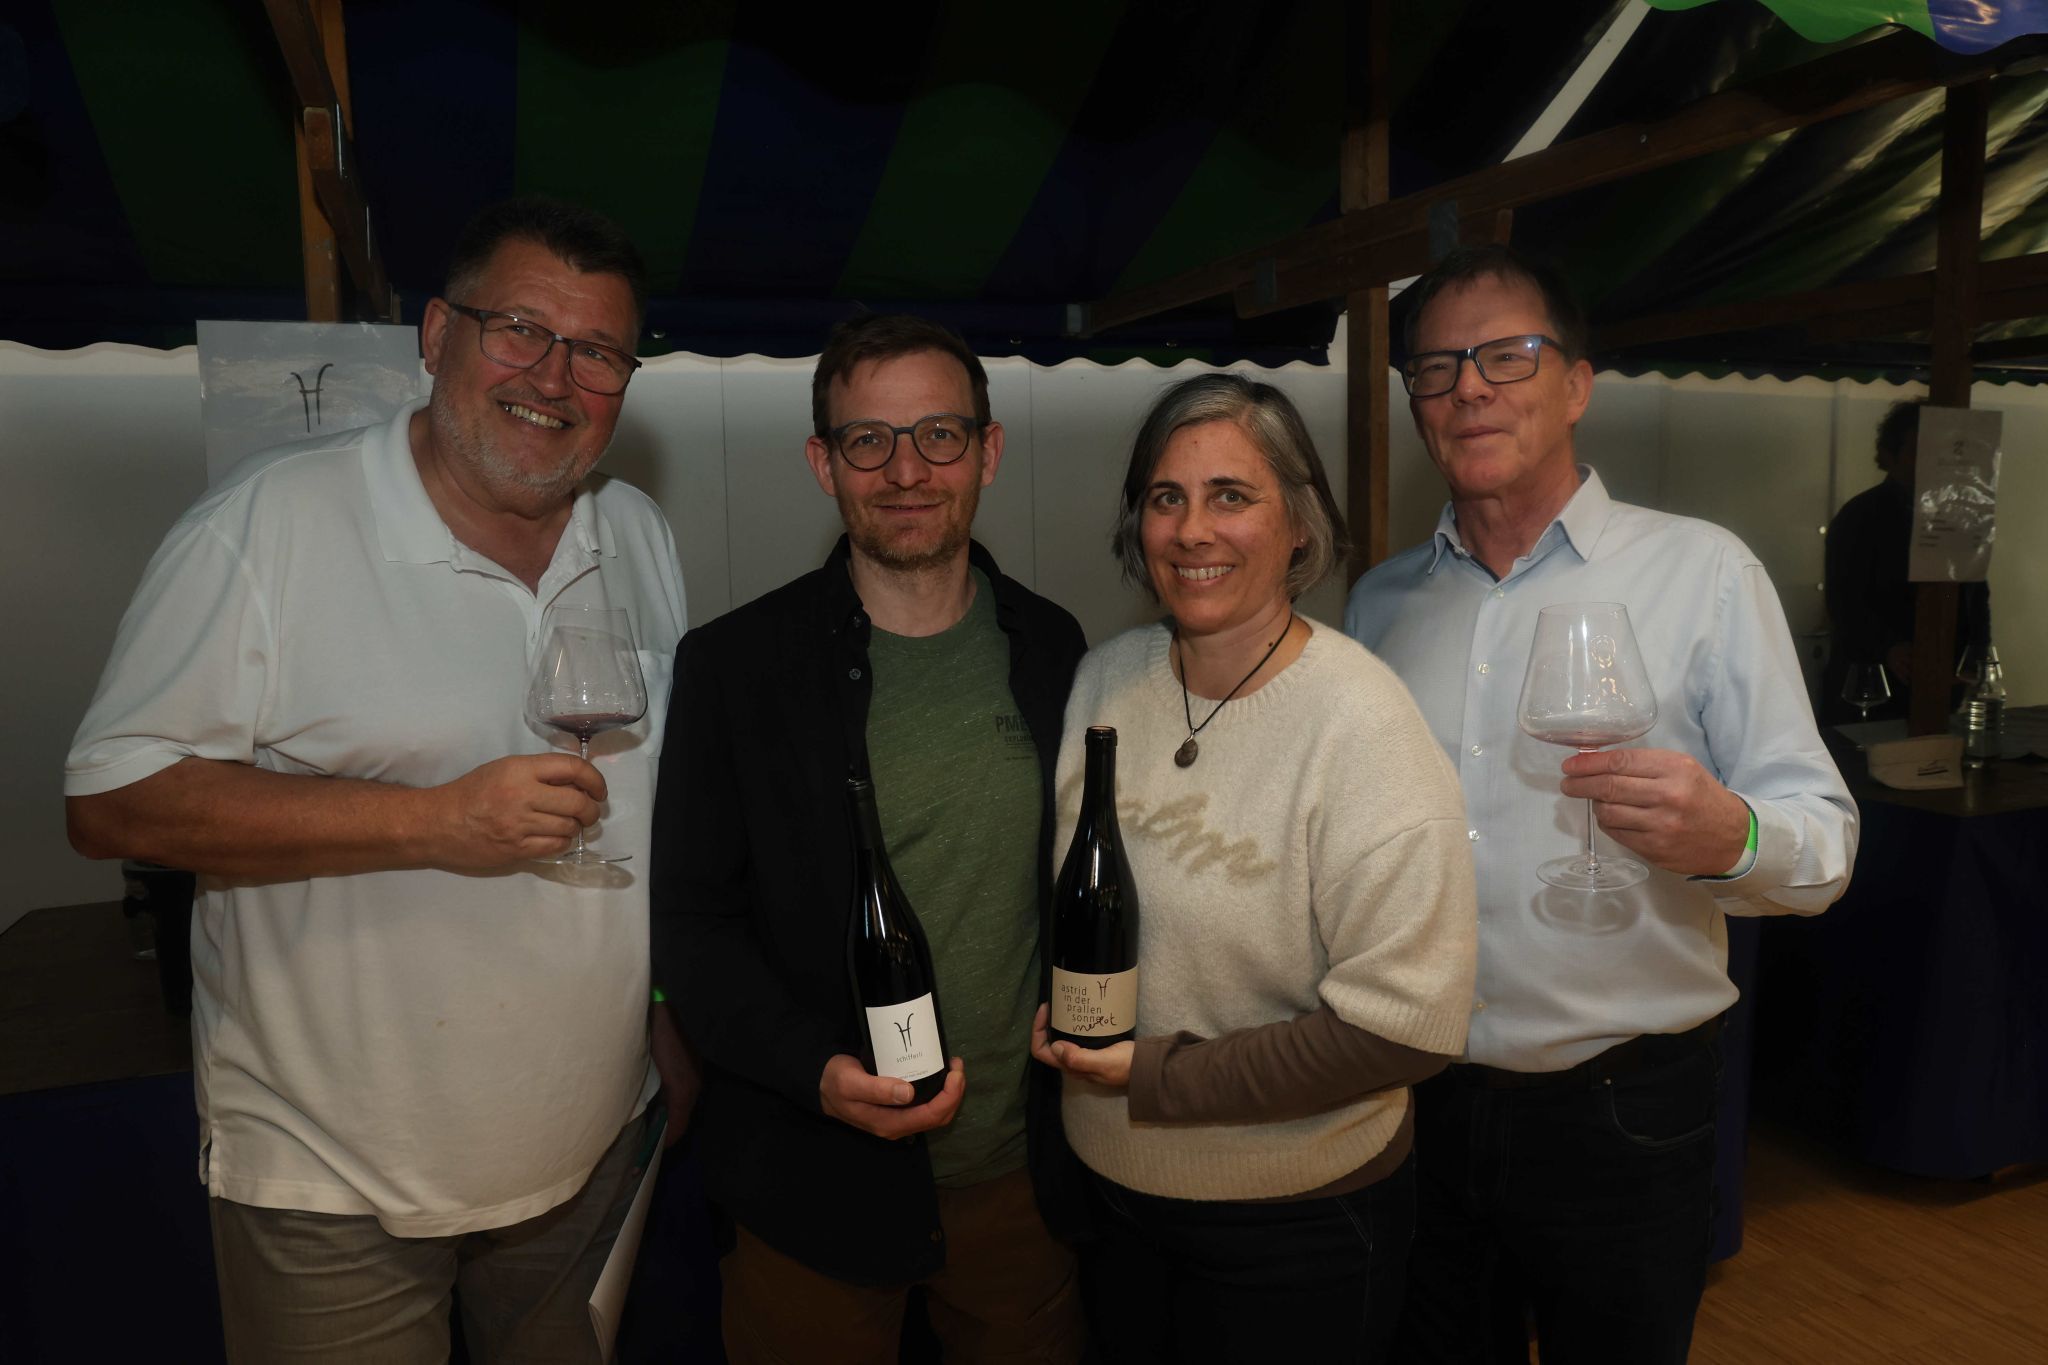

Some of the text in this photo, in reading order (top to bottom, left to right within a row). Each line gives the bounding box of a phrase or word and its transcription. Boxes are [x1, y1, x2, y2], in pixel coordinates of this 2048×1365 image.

[1061, 985, 1087, 996] astrid
[1064, 994, 1090, 1005] in der
[1067, 1004, 1102, 1014] prallen
